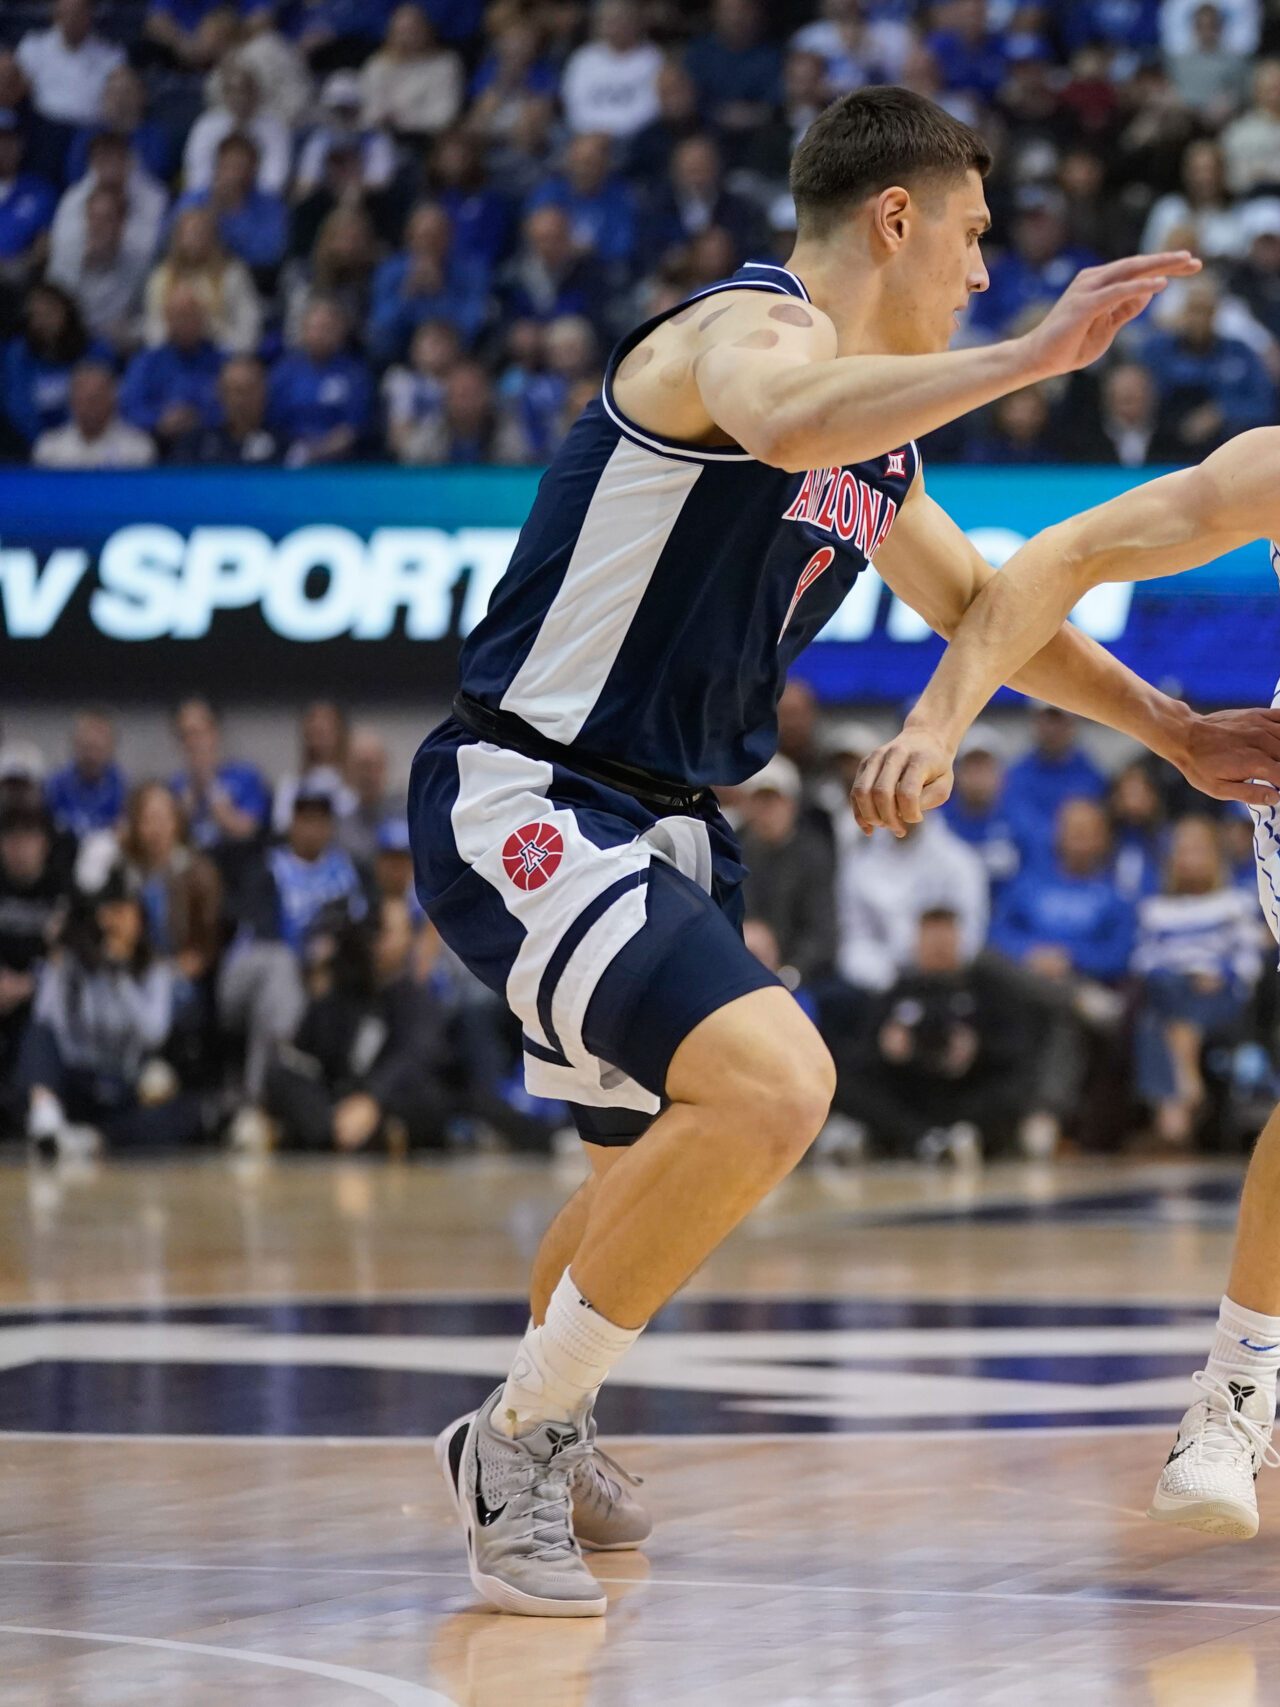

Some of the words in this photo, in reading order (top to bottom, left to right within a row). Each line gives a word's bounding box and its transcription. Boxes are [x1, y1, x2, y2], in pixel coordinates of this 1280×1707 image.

[782, 466, 897, 561] AZONA
[90, 523, 521, 642] SPORT
[520, 841, 549, 874] A
